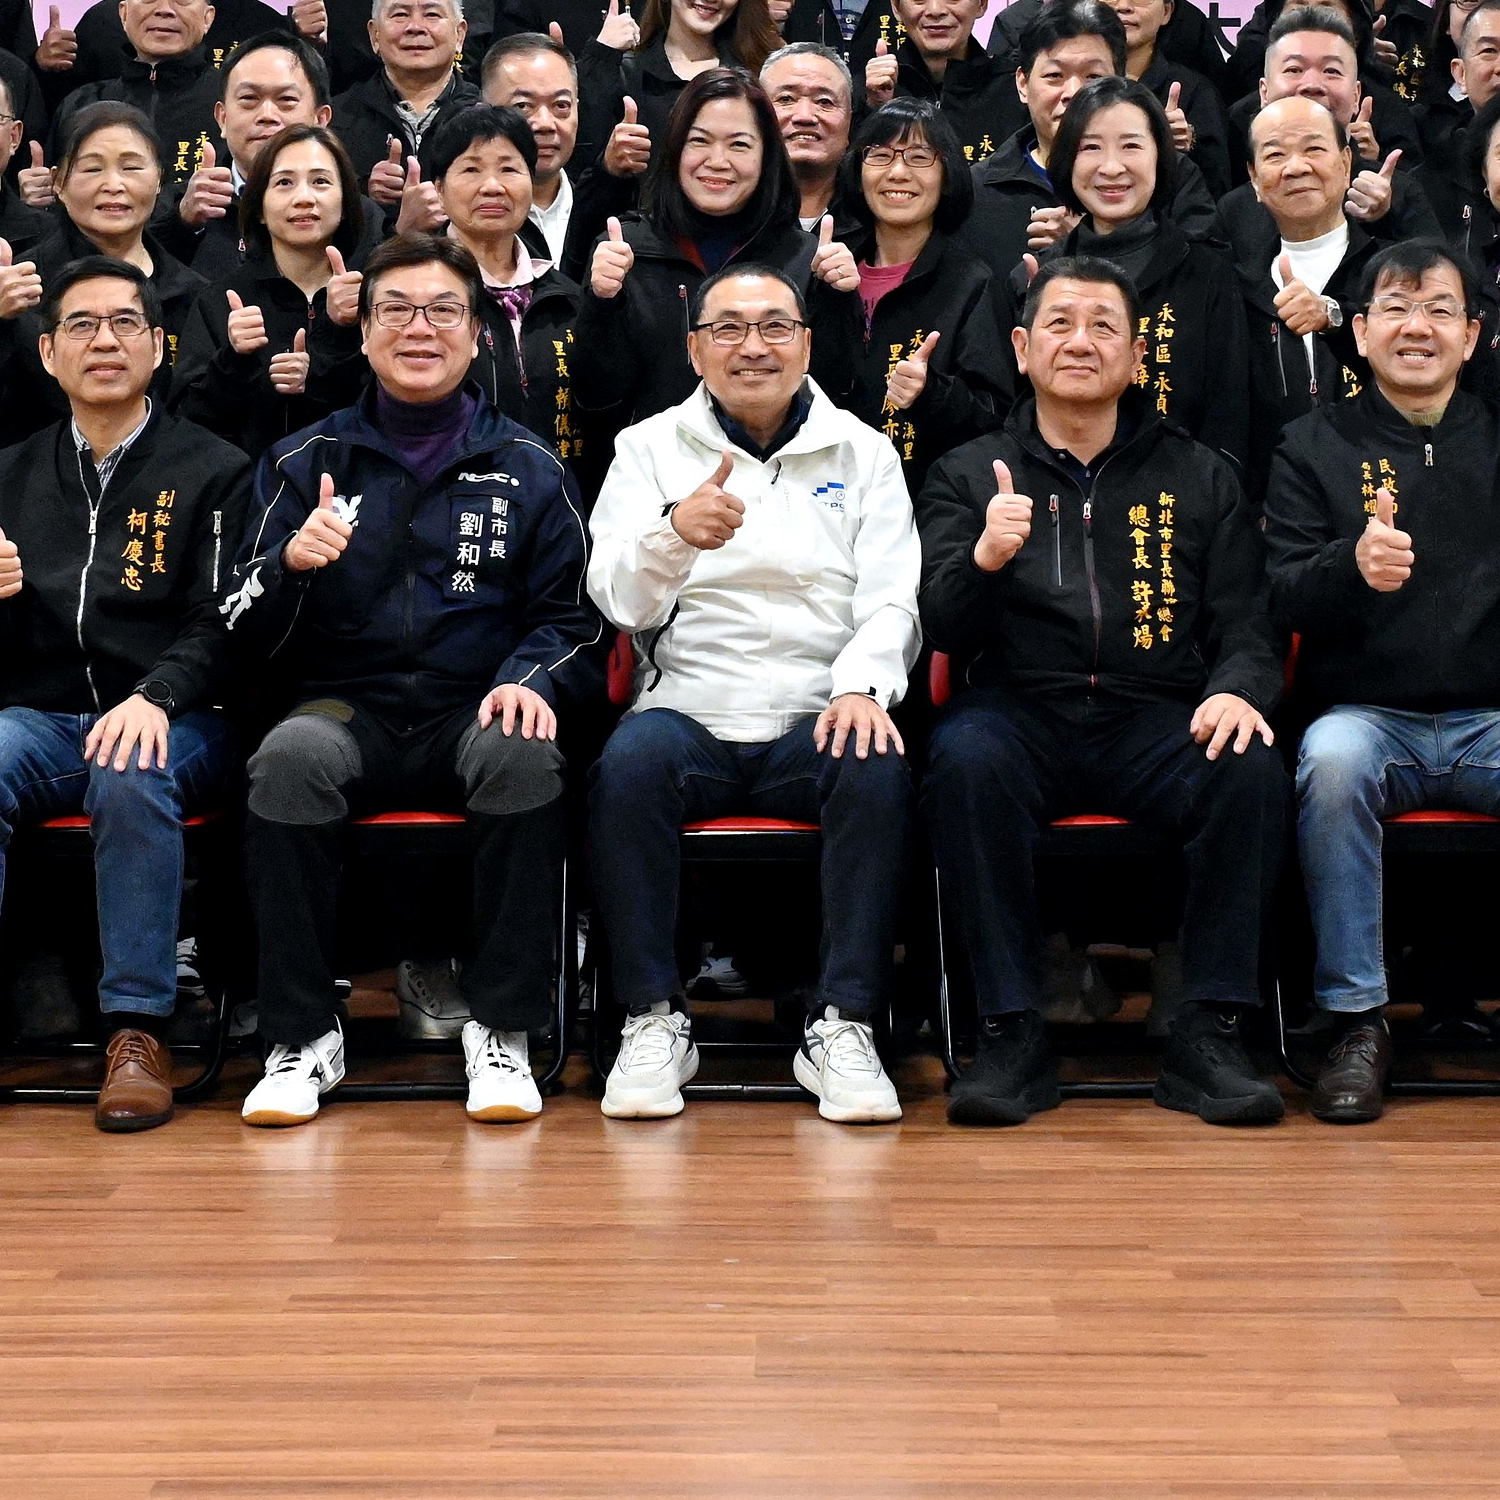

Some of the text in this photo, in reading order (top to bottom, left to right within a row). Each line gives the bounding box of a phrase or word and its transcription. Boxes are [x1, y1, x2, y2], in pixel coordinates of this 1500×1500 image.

[173, 141, 190, 172] 里長
[551, 339, 571, 378] 里長
[1154, 302, 1177, 364] 永和區
[120, 507, 149, 592] 柯慶忠
[451, 511, 484, 593] 劉和然
[488, 496, 509, 559] 副市長
[1127, 503, 1154, 570] 總會長
